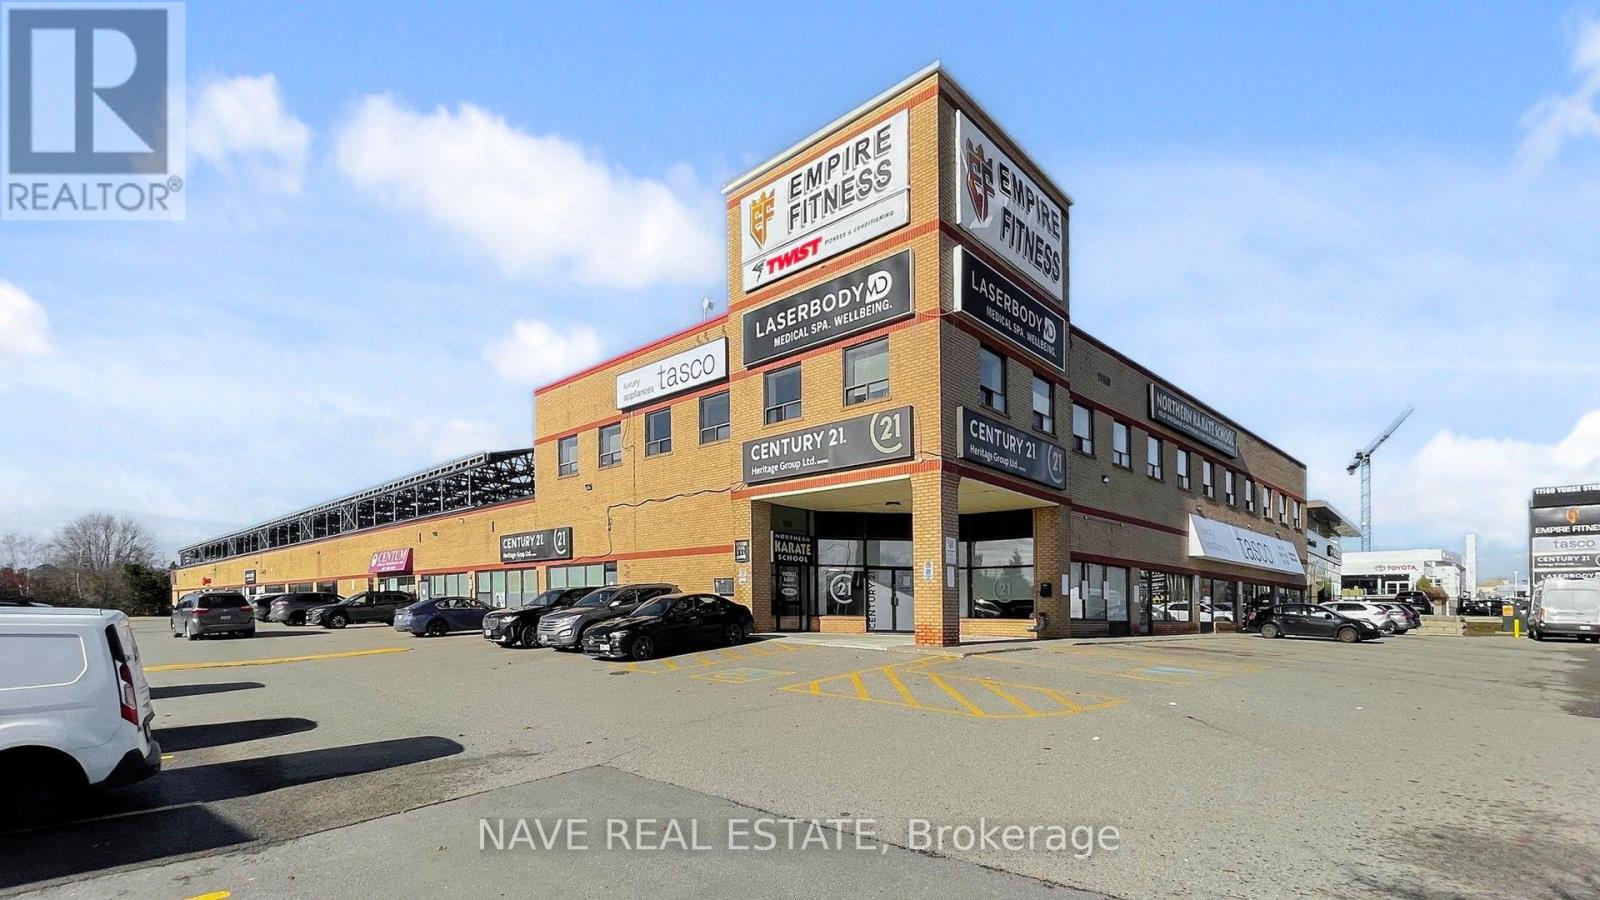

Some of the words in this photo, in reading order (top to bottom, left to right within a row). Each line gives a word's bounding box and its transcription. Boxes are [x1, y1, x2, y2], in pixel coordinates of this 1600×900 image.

[789, 123, 892, 202] EMPIRE
[789, 159, 892, 233] FITNESS
[999, 162, 1061, 240] EMPIRE
[766, 236, 823, 275] TWIST
[1000, 206, 1060, 283] FITNESS
[773, 327, 809, 348] MEDICAL
[811, 320, 831, 335] SPA.
[833, 299, 893, 328] WELLBEING.
[986, 306, 1013, 330] MEDICAL
[657, 354, 716, 390] tasco
[1156, 392, 1193, 425] NORTHERN
[750, 430, 825, 461] CENTURY
[970, 420, 1024, 455] CENTURY
[751, 463, 779, 476] Heritage
[779, 460, 801, 471] Group
[802, 456, 817, 466] Ltd.
[969, 444, 993, 463] Heritage
[993, 452, 1009, 467] Group
[502, 535, 535, 549] CENTURY
[774, 533, 811, 542] NORTHERN
[1535, 526, 1571, 534] EMPIRE
[1552, 539, 1596, 549] tasco
[774, 540, 812, 556] KARATE
[778, 554, 809, 563] SCHOOL
[1236, 530, 1274, 565] tasco
[868, 582, 876, 630] CENTURY
